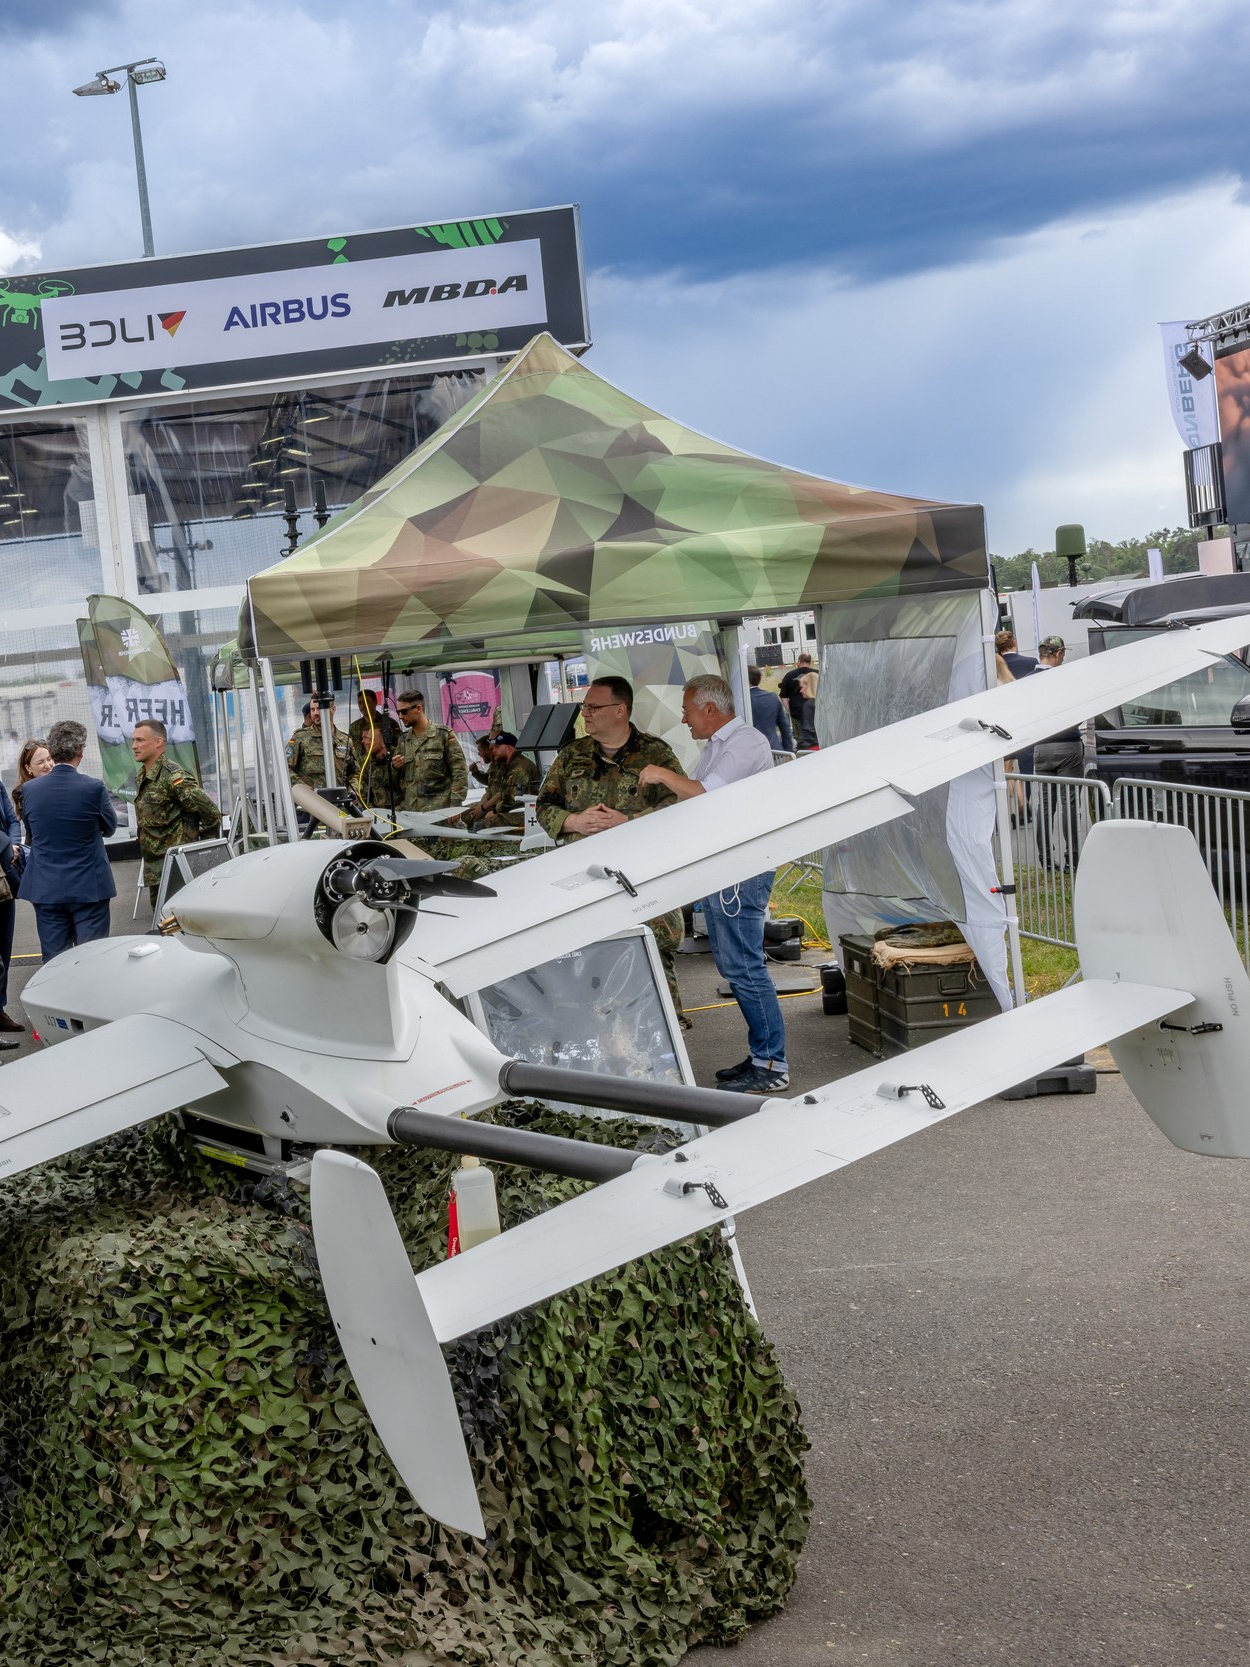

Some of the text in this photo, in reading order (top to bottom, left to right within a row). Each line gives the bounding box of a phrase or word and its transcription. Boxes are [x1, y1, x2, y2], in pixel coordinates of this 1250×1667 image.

[382, 274, 528, 308] MBDA
[223, 293, 351, 331] AIRBUS
[1224, 977, 1240, 1017] NO PUSH
